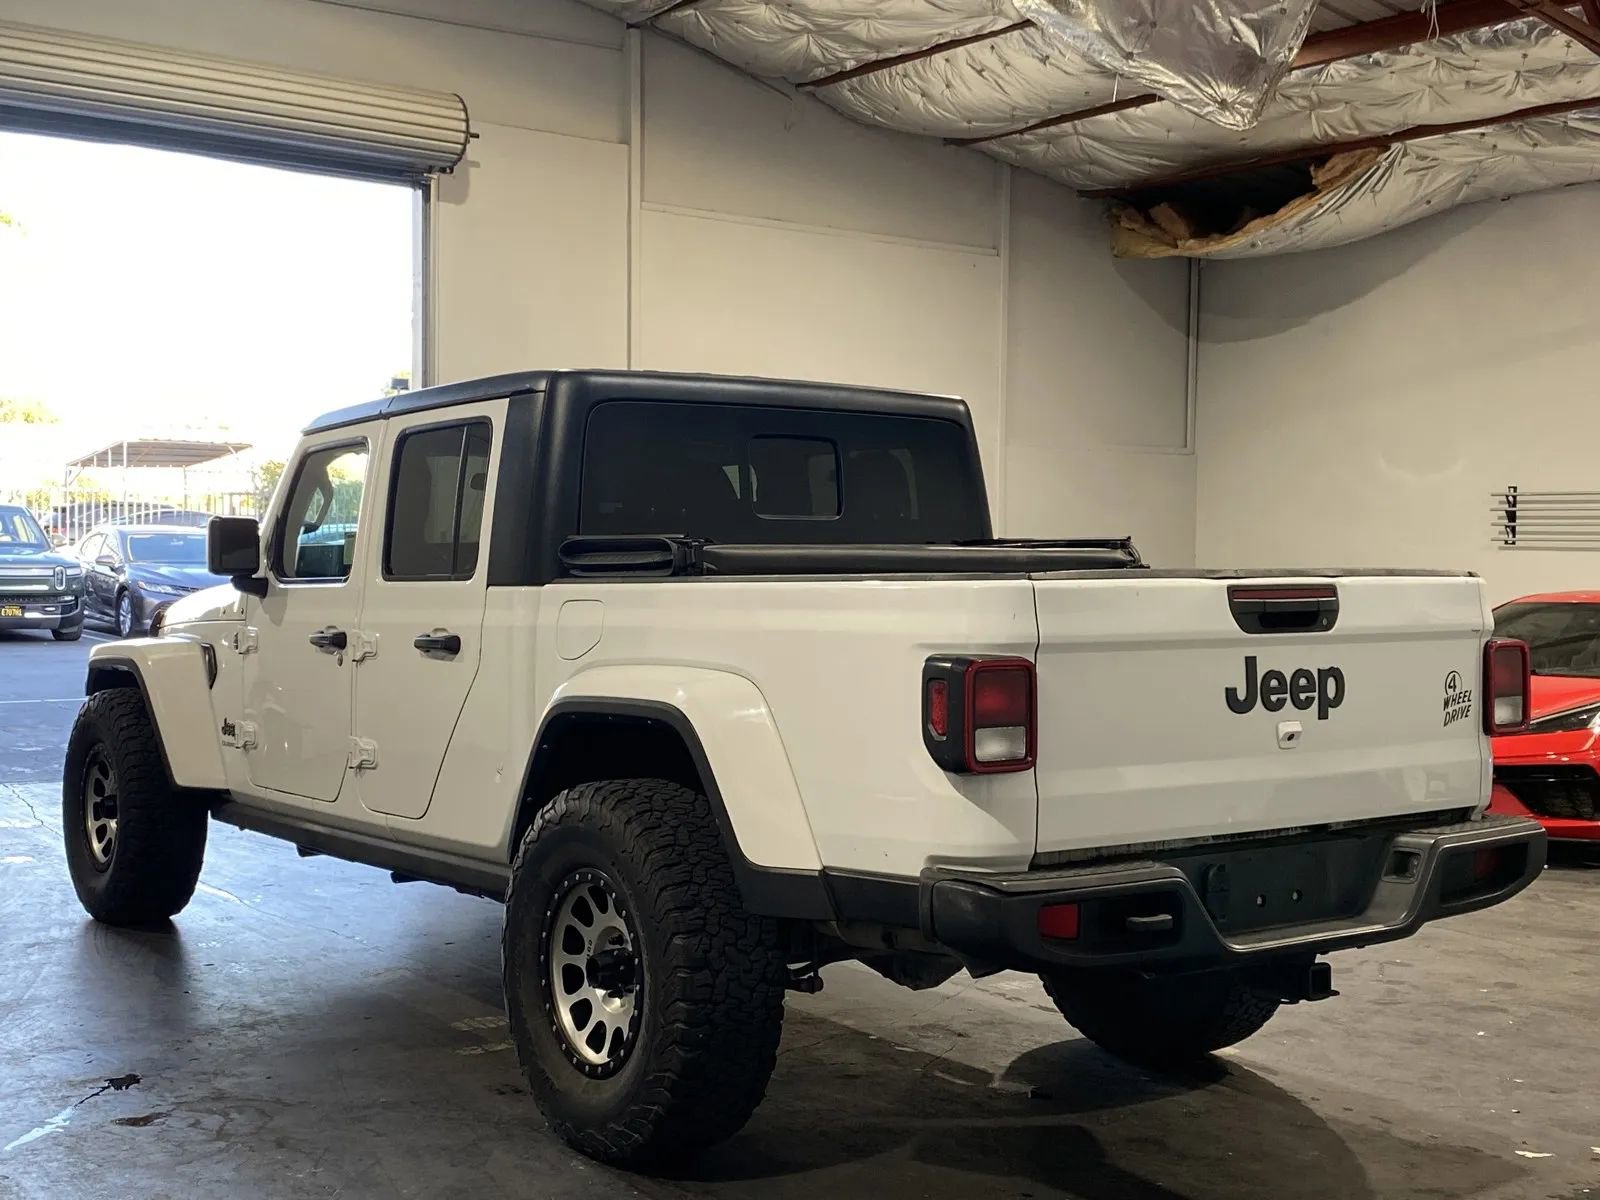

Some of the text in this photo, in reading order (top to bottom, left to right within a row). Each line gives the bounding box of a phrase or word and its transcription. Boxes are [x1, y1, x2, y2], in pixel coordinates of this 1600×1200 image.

[1225, 655, 1346, 720] Jeep
[1447, 673, 1457, 692] 4
[1443, 690, 1473, 711] WHEEL
[1443, 704, 1472, 727] DRIVE
